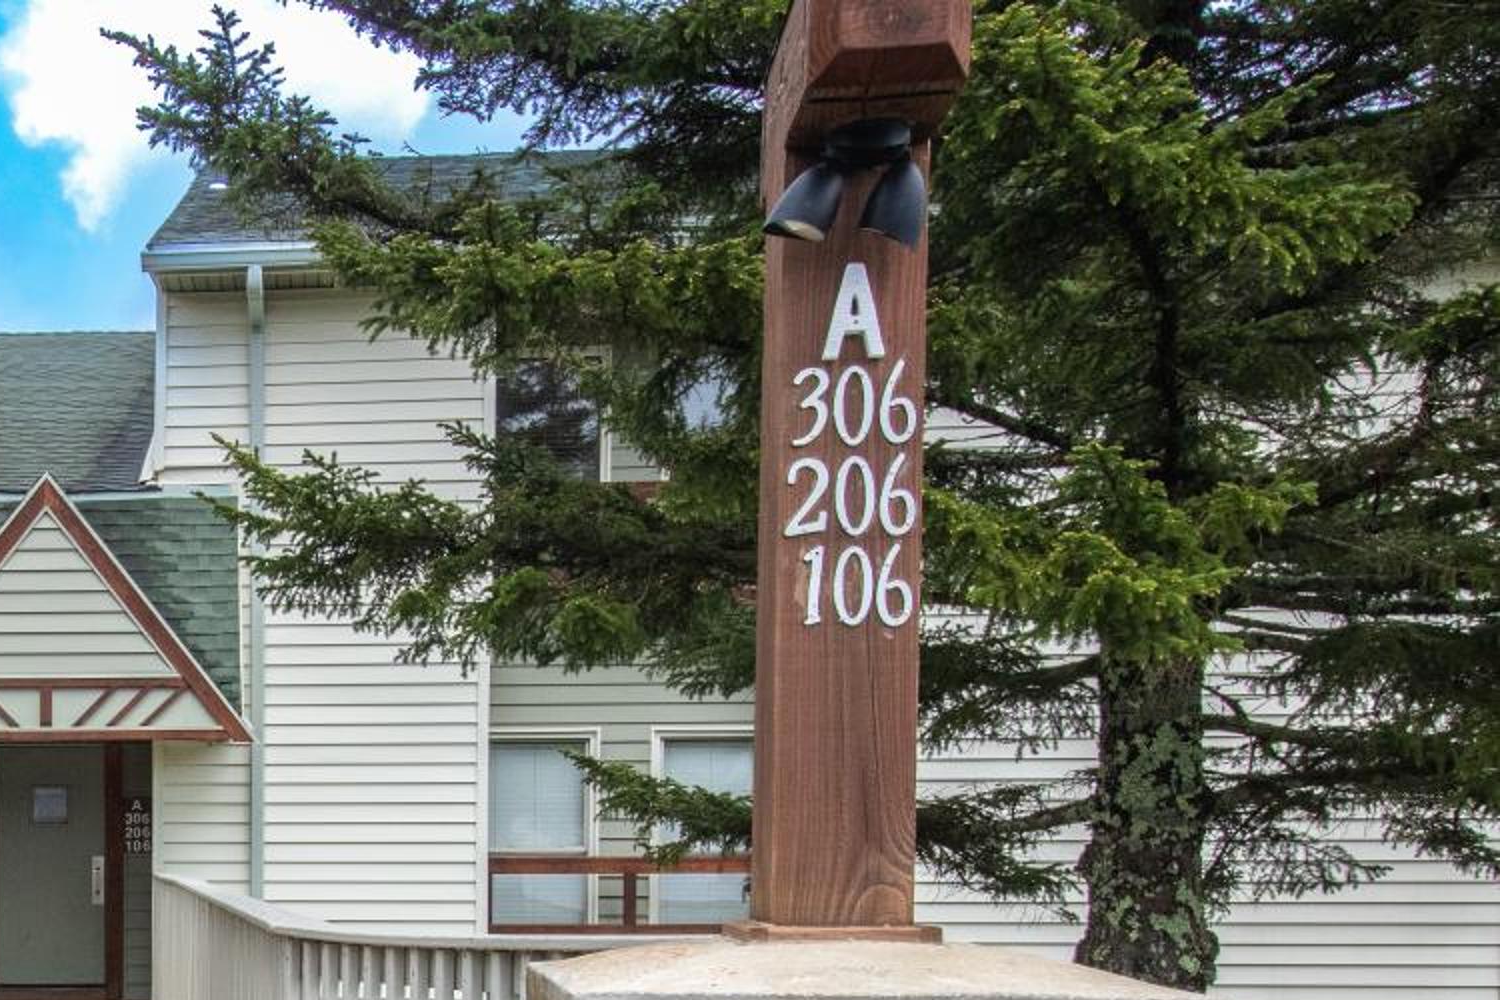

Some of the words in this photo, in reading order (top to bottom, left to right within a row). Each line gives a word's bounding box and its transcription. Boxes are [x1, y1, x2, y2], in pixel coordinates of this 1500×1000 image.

[821, 262, 885, 360] A
[792, 357, 918, 447] 306
[783, 452, 918, 538] 206
[802, 543, 914, 627] 106
